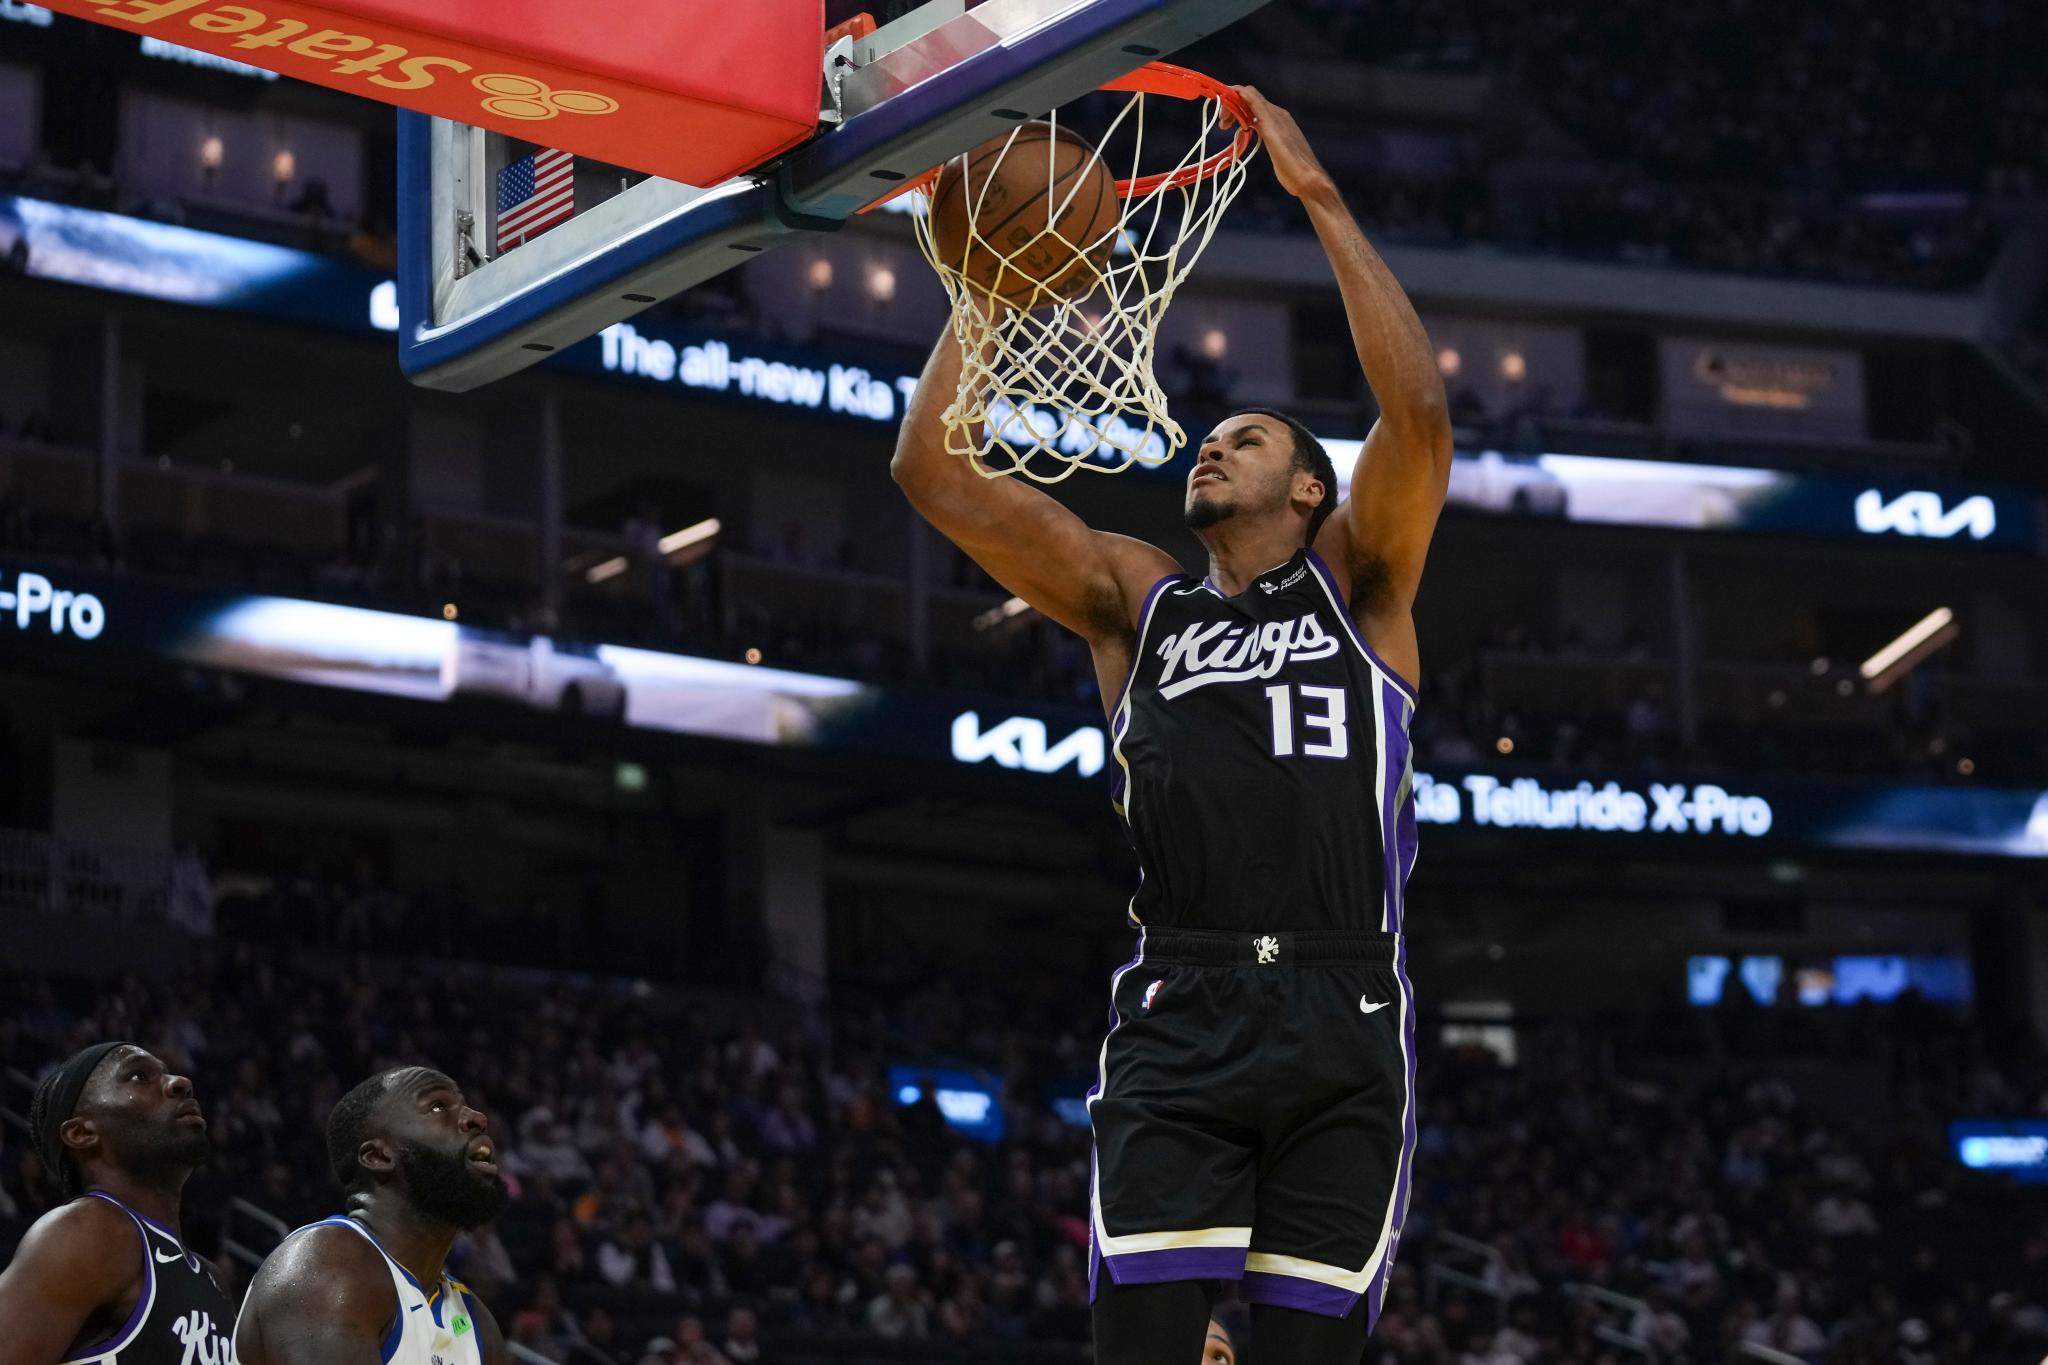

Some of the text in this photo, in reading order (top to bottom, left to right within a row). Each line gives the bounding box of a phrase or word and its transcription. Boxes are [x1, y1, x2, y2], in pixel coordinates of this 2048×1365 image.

[188, 5, 473, 90] State
[597, 322, 676, 382] The
[679, 339, 826, 408] all-new
[827, 363, 894, 421] Kia
[0, 571, 105, 640] -Pro
[1156, 611, 1340, 701] Kings
[1264, 683, 1349, 759] 13
[1462, 775, 1648, 832] Telluride
[1648, 782, 1773, 836] X-Pro
